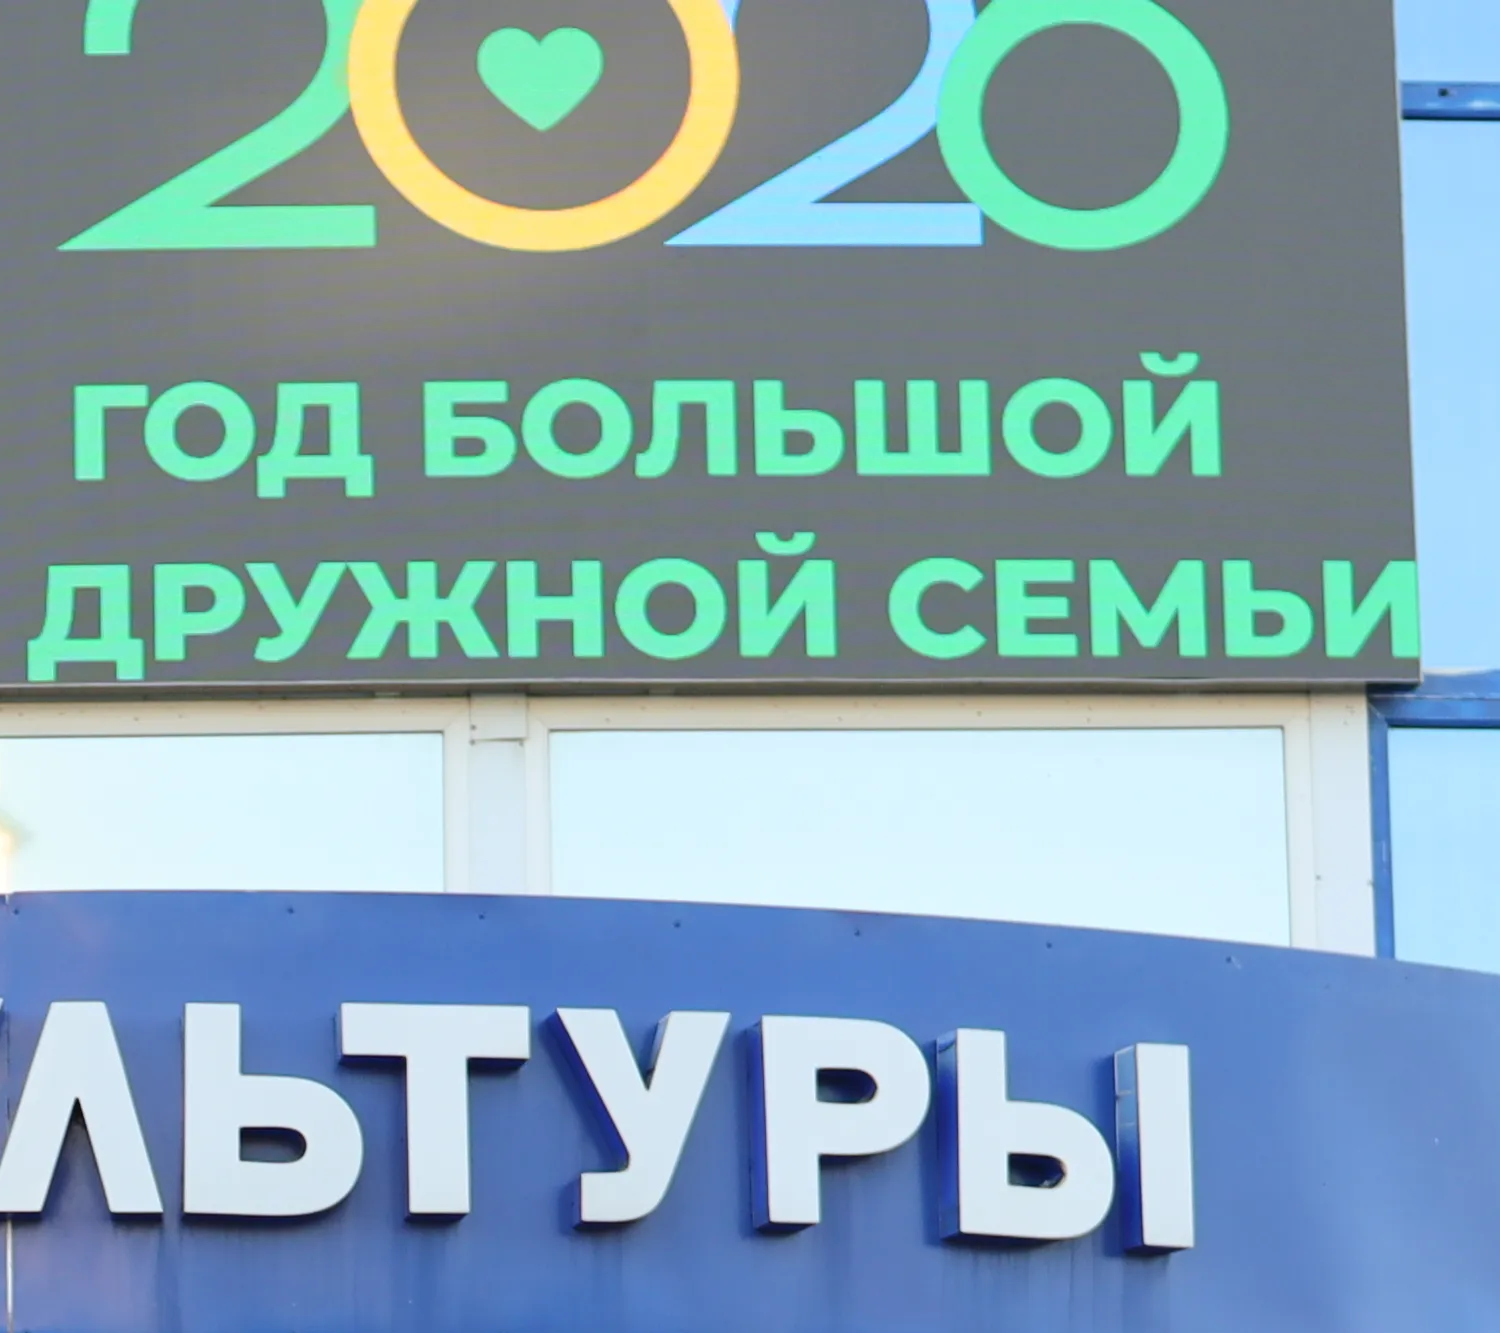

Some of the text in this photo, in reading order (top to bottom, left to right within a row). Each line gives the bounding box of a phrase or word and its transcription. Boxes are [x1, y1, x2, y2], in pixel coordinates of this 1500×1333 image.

[74, 351, 1221, 498] ГОД БОЛЬШОЙ
[27, 532, 836, 681] ДРУЖНОЙ
[888, 557, 1420, 659] СЕМЬИ
